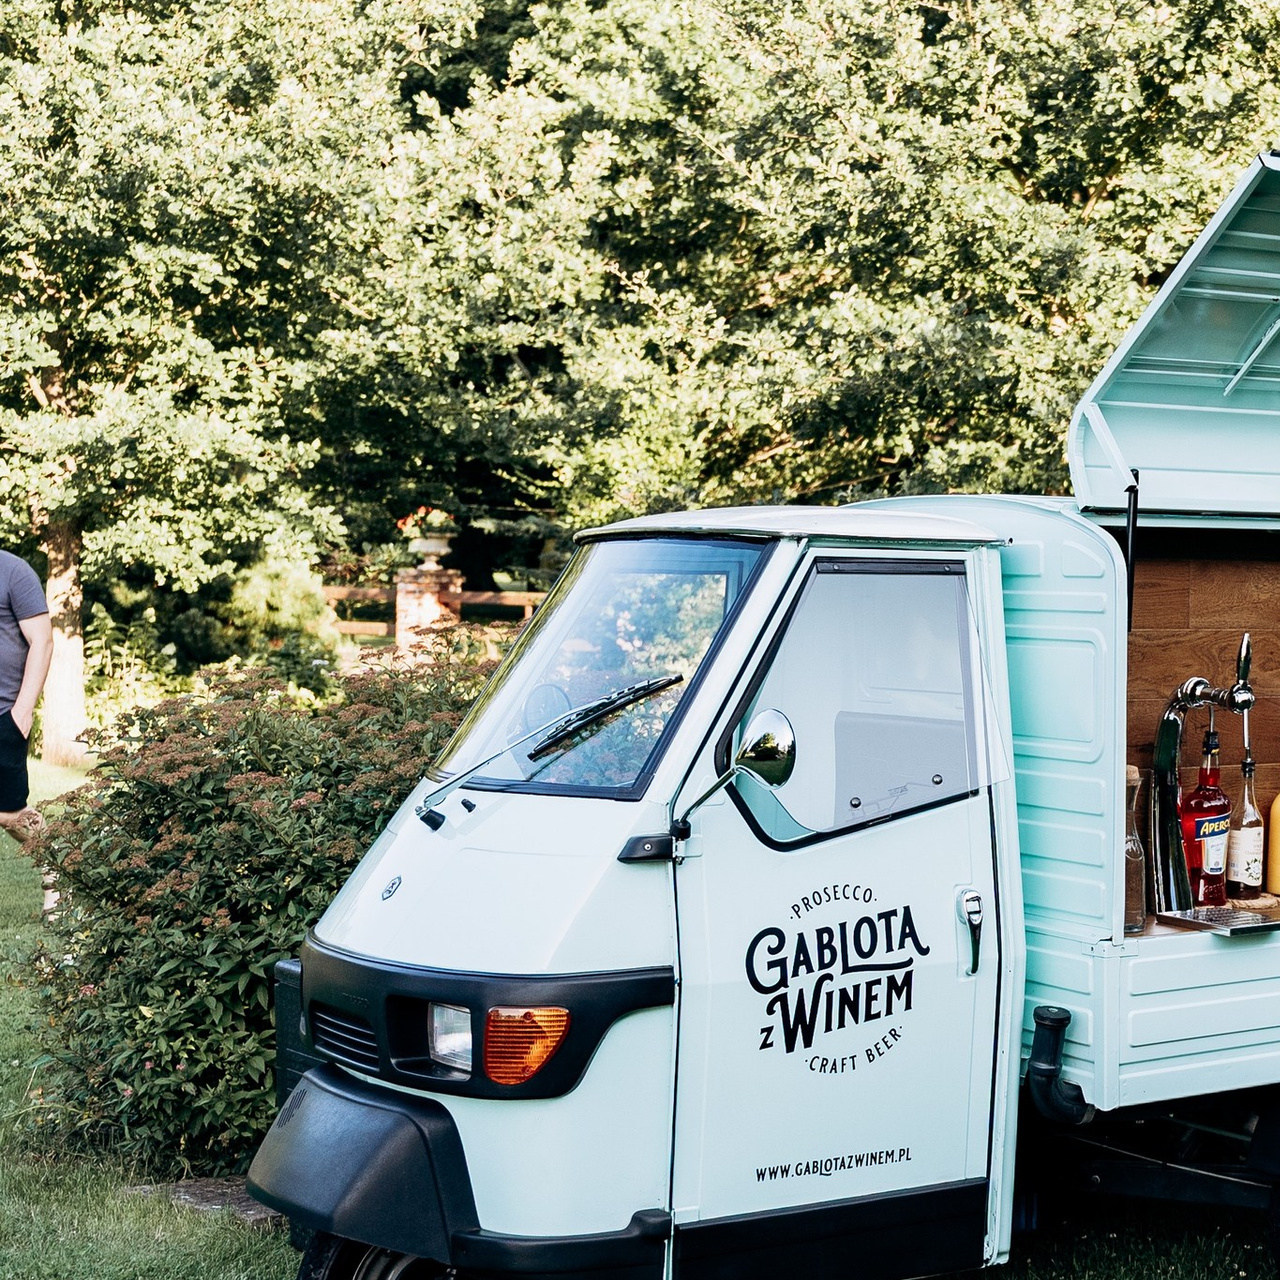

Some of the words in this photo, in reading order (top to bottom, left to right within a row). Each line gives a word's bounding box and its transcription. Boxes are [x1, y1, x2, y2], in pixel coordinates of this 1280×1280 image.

[1200, 818, 1230, 836] APERO
[791, 884, 873, 919] PROSECCO
[745, 905, 931, 995] GABLOTA
[765, 969, 914, 1054] WINEM
[809, 1054, 857, 1074] CRAFT
[865, 1027, 902, 1064] BEER
[756, 1147, 912, 1182] WWW.GABLOTAZWINEM.PL
